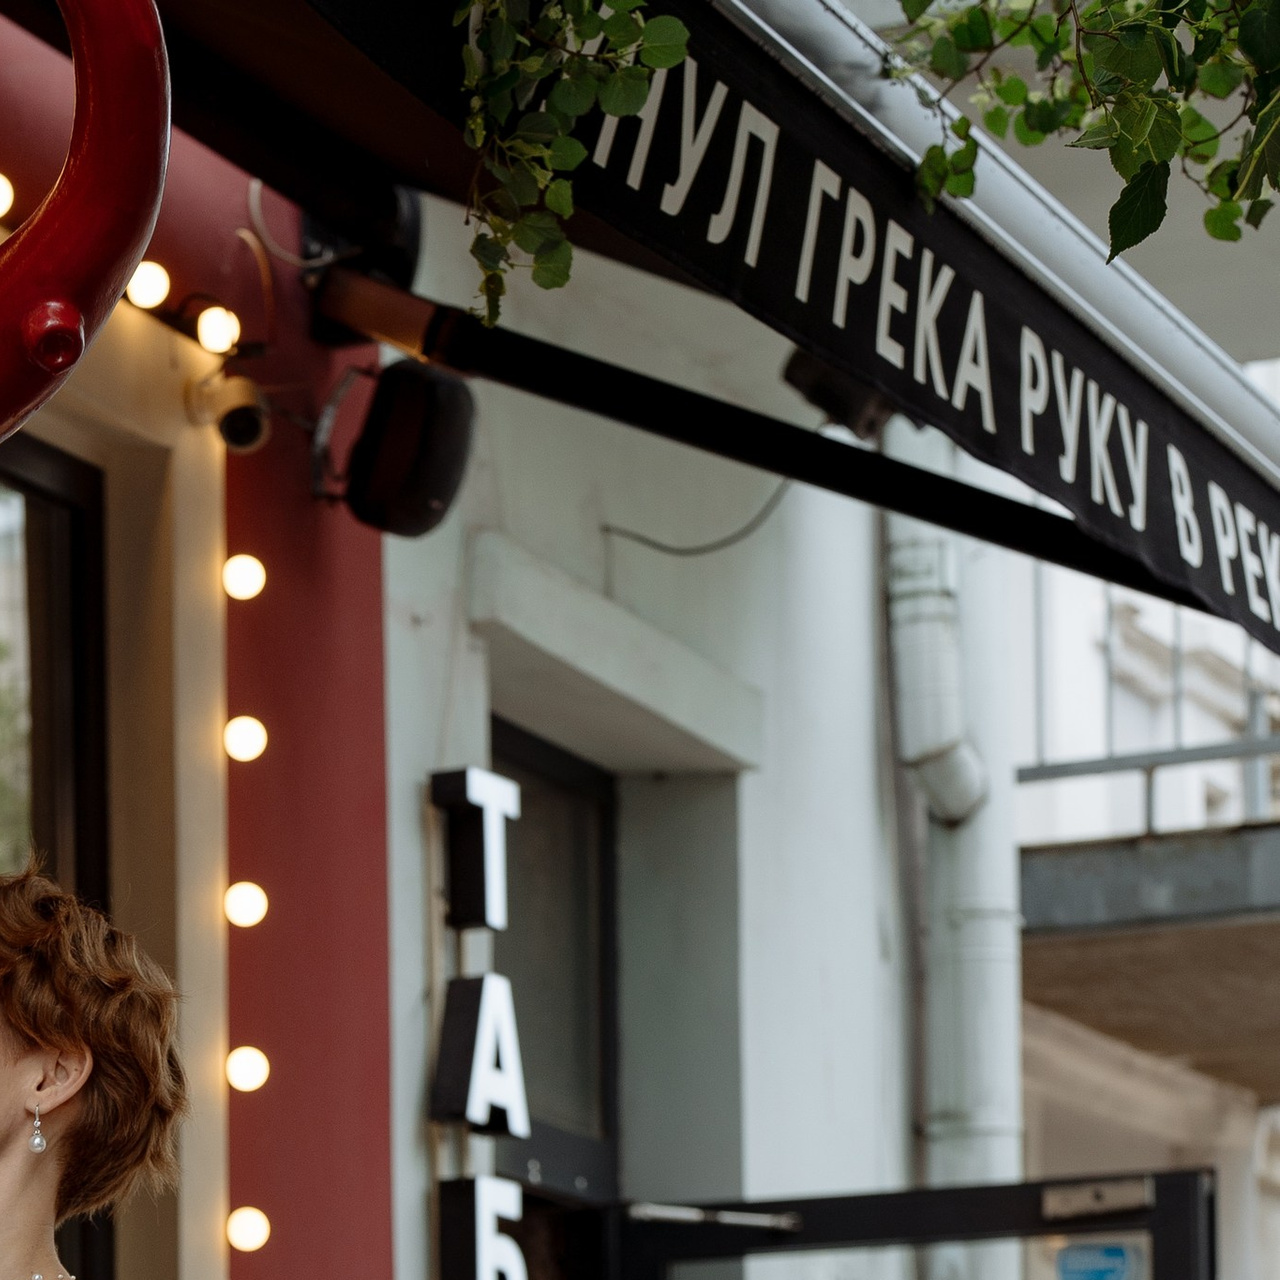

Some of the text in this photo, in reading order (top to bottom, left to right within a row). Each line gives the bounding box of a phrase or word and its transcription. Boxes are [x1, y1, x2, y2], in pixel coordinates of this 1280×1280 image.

[794, 158, 997, 434] ГРЕКА
[1021, 325, 1149, 532] РУКУ
[1167, 443, 1203, 569] В
